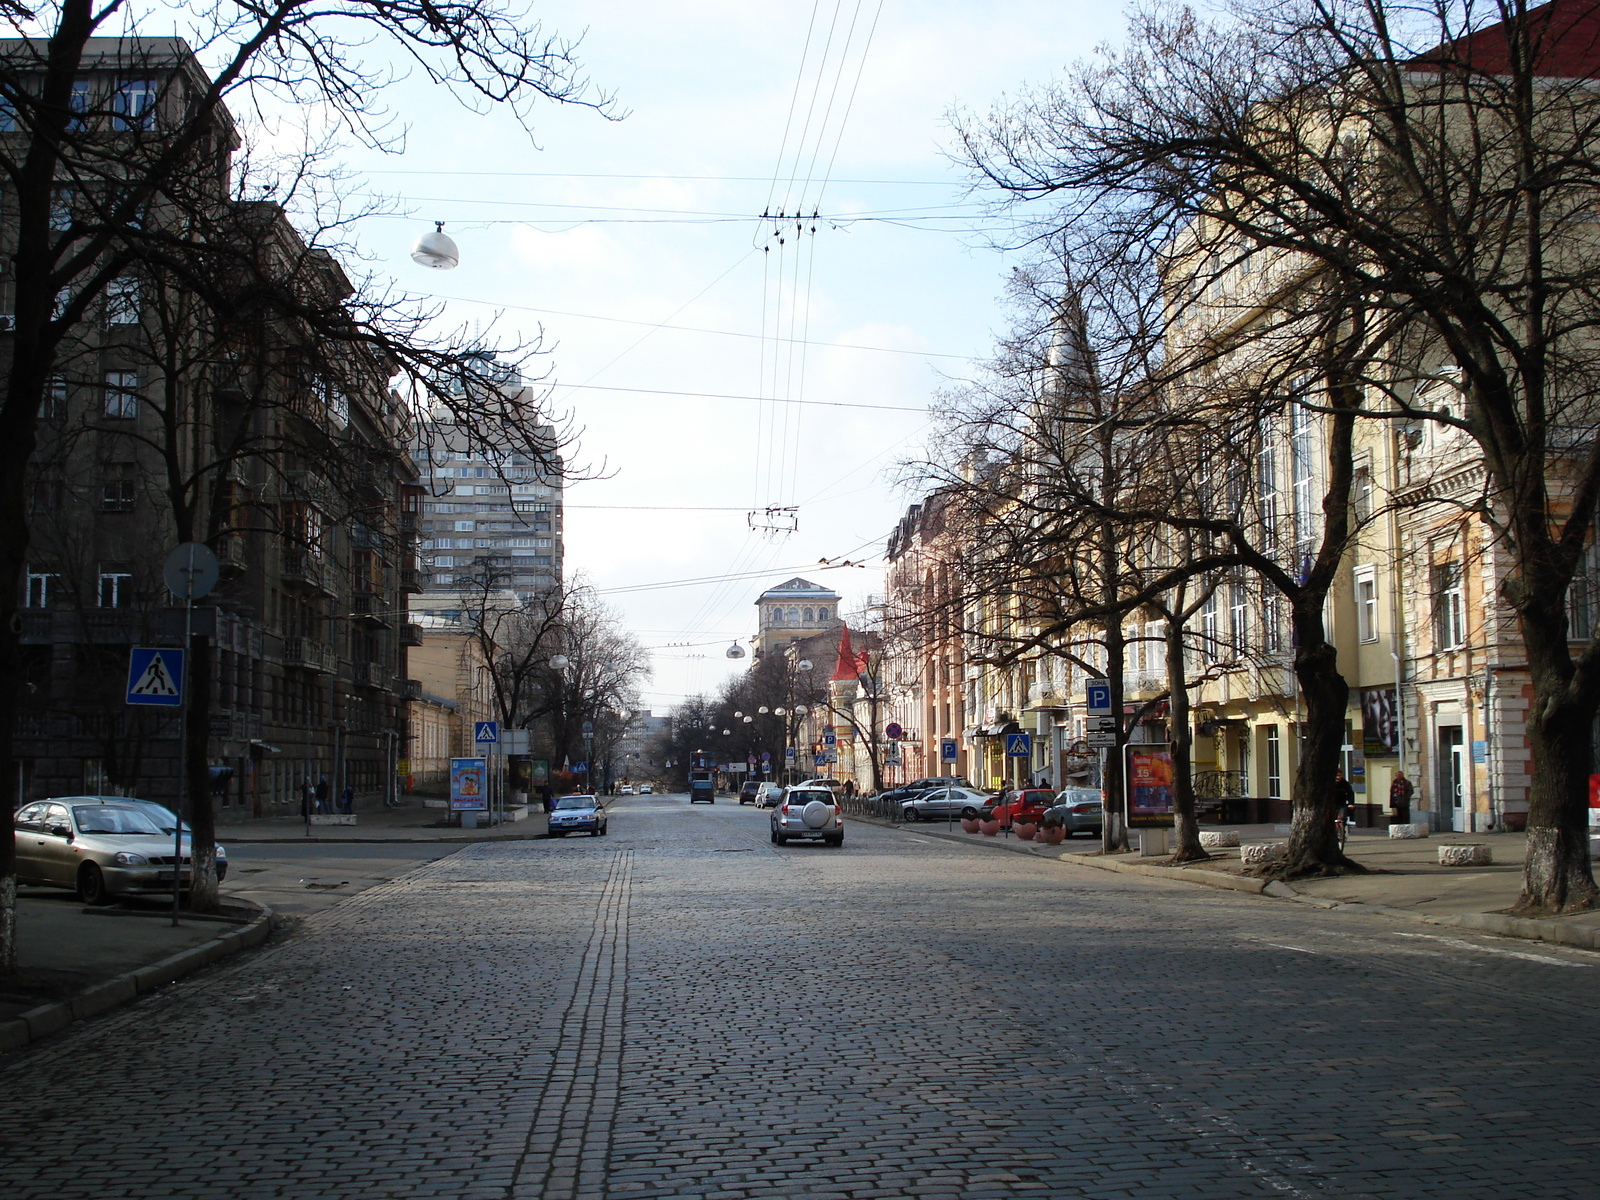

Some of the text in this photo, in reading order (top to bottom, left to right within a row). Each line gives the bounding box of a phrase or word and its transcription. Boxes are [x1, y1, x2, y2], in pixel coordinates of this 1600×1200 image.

[1093, 690, 1106, 707] P
[827, 736, 834, 744] P
[945, 745, 953, 756] P
[1136, 769, 1150, 778] 15
